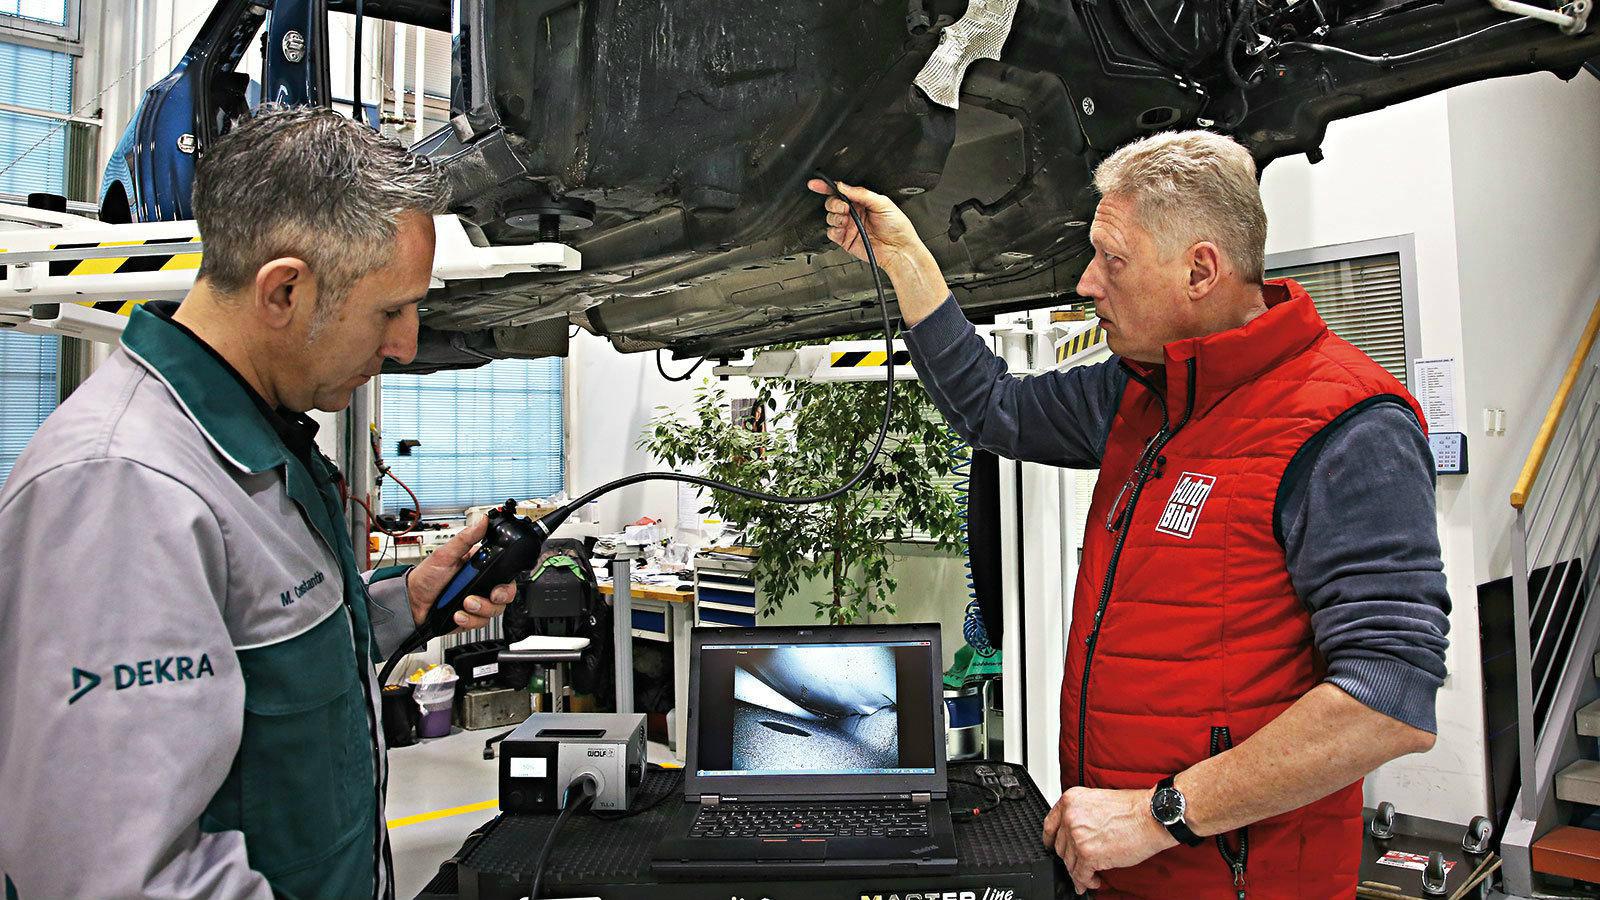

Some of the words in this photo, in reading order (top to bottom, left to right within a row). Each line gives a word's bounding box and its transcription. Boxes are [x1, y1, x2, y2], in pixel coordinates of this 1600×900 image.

[1172, 476, 1211, 507] Auto
[1159, 503, 1197, 533] Bild
[280, 590, 294, 607] M.
[113, 653, 215, 691] DEKRA
